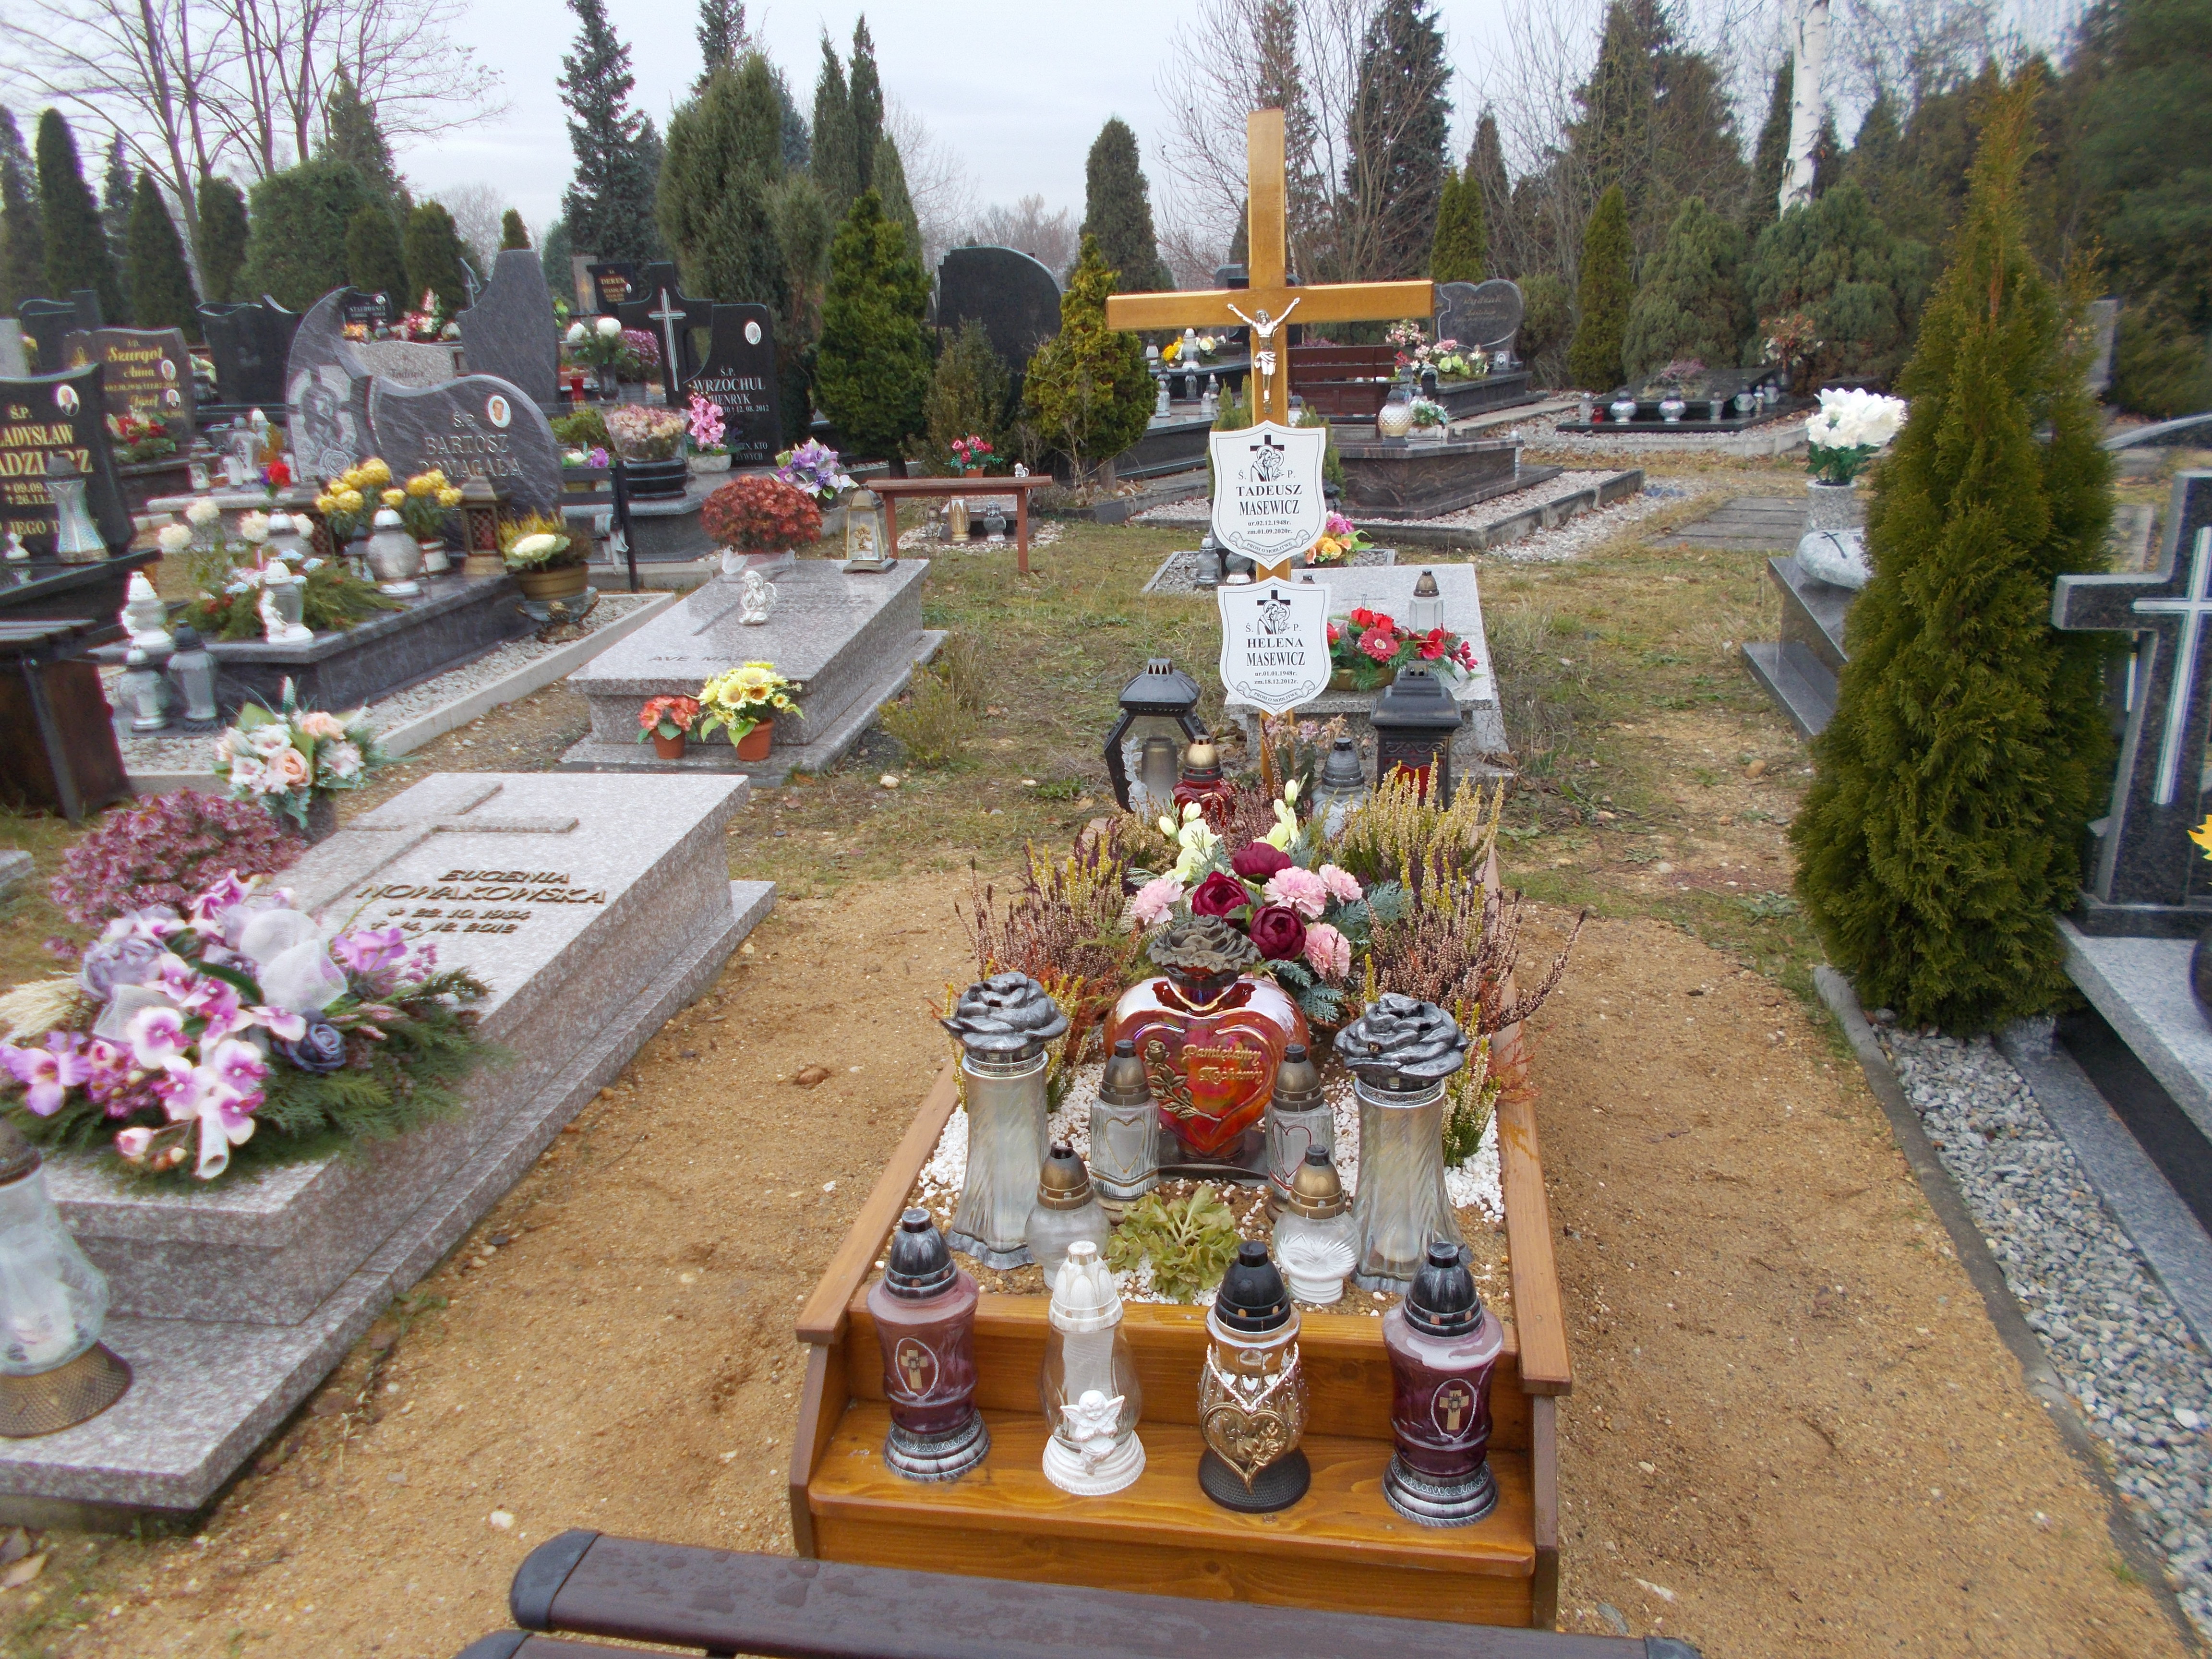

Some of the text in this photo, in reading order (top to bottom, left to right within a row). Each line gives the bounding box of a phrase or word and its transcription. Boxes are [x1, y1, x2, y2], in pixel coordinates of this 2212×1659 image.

[694, 377, 766, 393] WRZOCHUL
[711, 394, 751, 405] HENRYK
[0, 424, 73, 446] ADYSŁAW
[425, 434, 509, 455] BARTOSZ
[1236, 484, 1302, 496] TADEUSZ
[1239, 500, 1299, 516] MASEWICZ
[1247, 542, 1261, 552] PROSI
[1247, 637, 1304, 648] HELENA
[1247, 652, 1305, 666] MASEWICZ
[1254, 692, 1267, 700] PROSI
[437, 870, 570, 884] EUGENIA
[355, 885, 607, 904] NOWAKOWSKA
